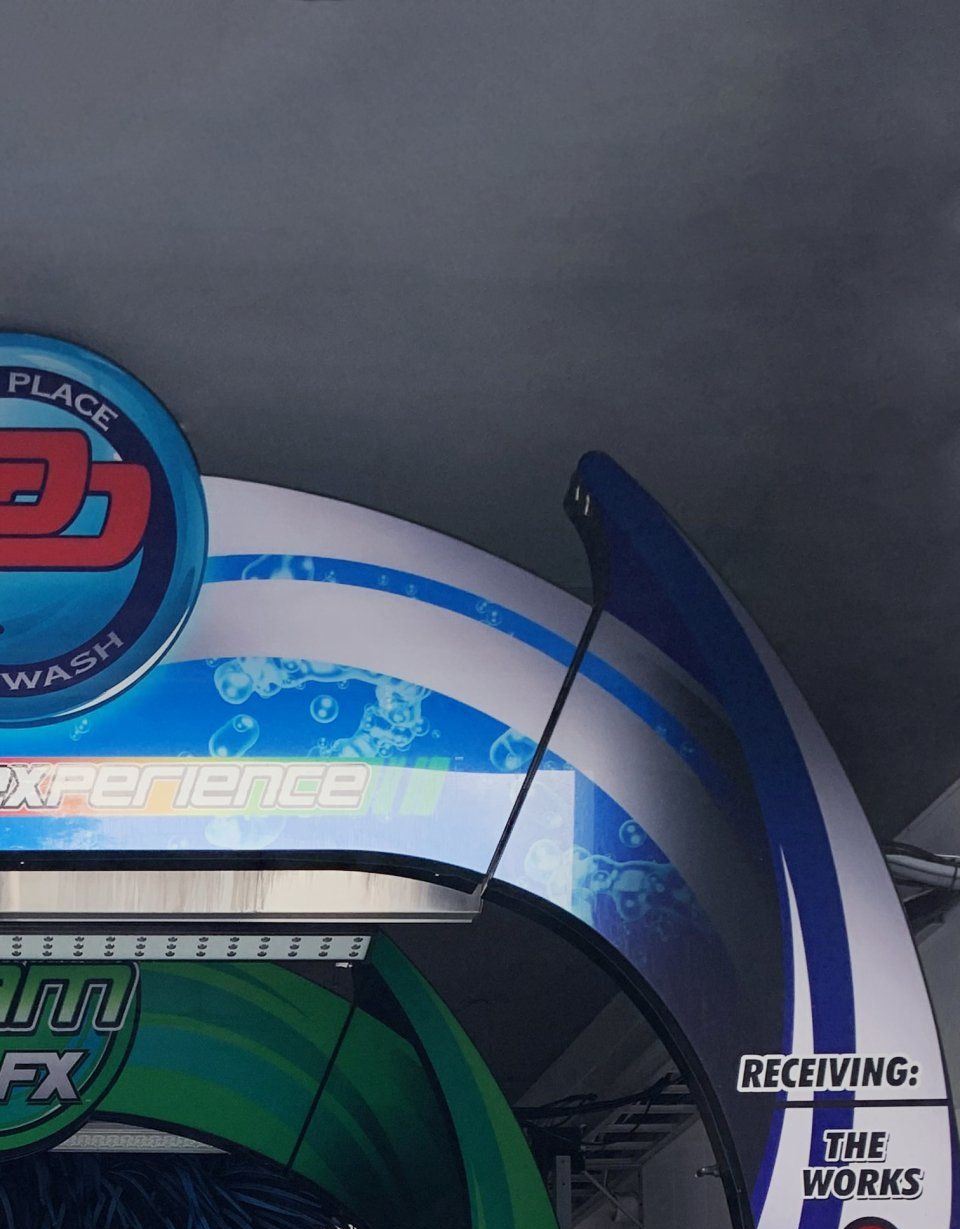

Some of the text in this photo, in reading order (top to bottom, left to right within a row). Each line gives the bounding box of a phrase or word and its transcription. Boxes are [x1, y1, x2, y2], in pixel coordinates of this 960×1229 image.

[7, 372, 120, 432] PLACE
[0, 631, 125, 690] WASH
[742, 1056, 920, 1088] RECEIVING:
[825, 1131, 887, 1160] THE
[803, 1168, 922, 1198] WORKS
